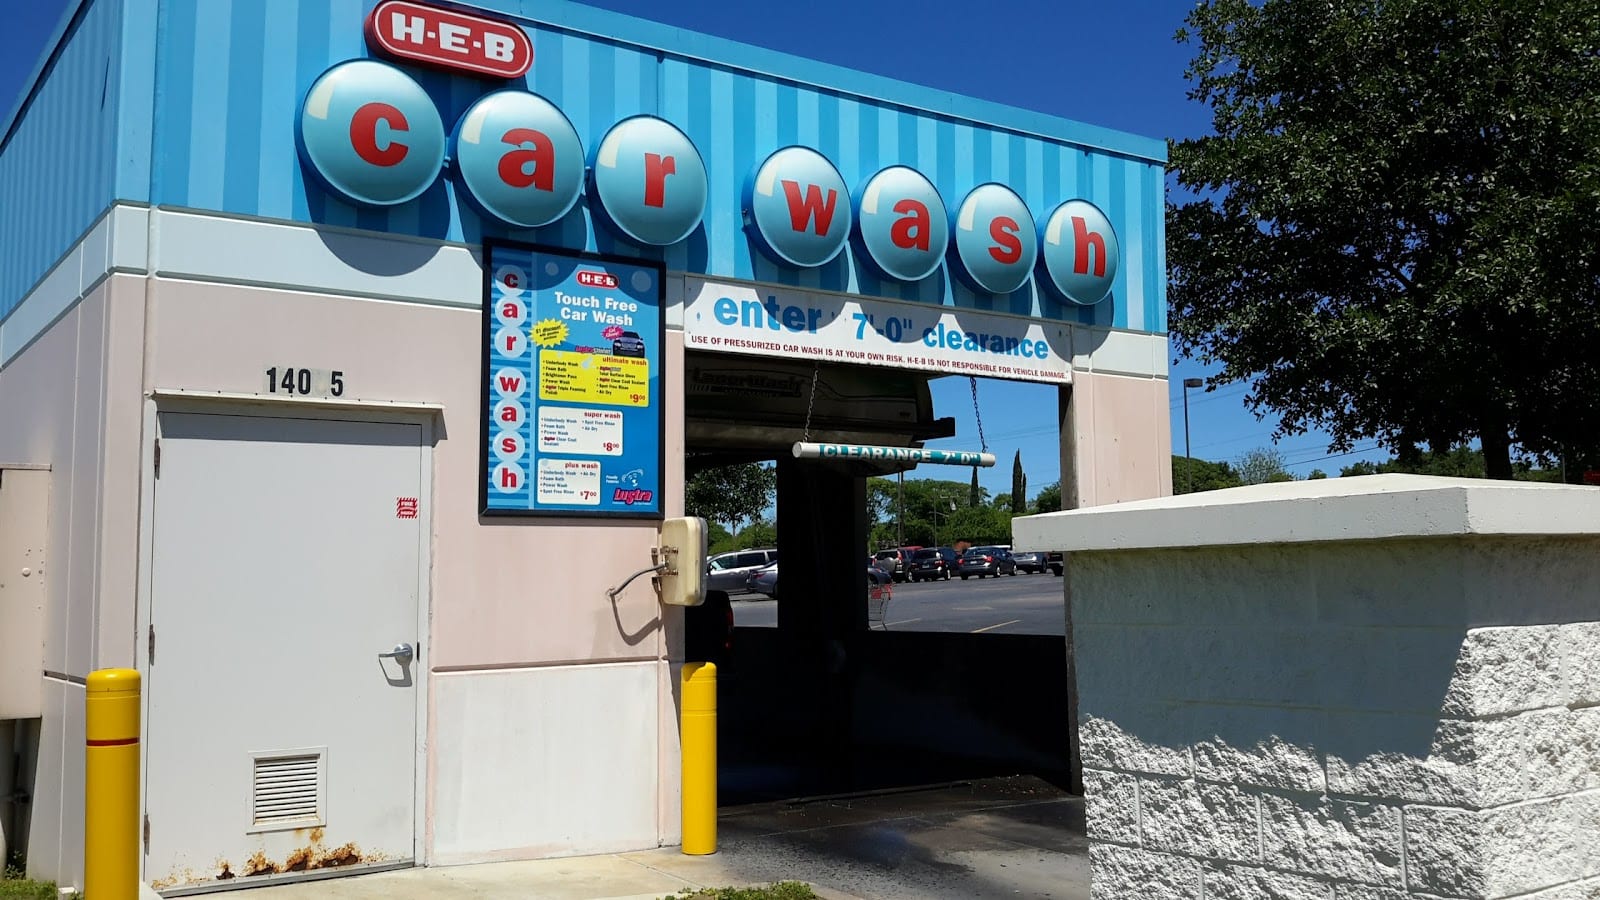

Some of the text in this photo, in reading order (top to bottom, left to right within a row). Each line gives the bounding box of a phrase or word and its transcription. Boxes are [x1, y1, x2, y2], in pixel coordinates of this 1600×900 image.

[391, 12, 516, 63] H-E-B
[350, 102, 1106, 278] car wash
[554, 291, 638, 313] Touch Free
[560, 307, 633, 326] Car Wash
[713, 295, 822, 334] enter
[922, 323, 1049, 359] clearance
[602, 356, 629, 364] ultimate
[691, 335, 708, 344] USE
[710, 337, 722, 345] OF
[724, 338, 781, 351] PRESSURIZED
[783, 344, 800, 353] CAR
[801, 345, 824, 356] WASH
[825, 348, 833, 357] IS
[835, 349, 844, 358] AT
[845, 350, 866, 360] YOUR
[867, 352, 885, 362] OWN
[886, 354, 905, 364] RISK.
[907, 356, 927, 366] H-E-B
[928, 358, 935, 366] IS
[937, 359, 950, 368] NOT
[952, 360, 997, 373] RESPONSIBLE
[998, 365, 1012, 374] FOR
[1013, 366, 1039, 378] VEHICLE
[266, 367, 344, 396] 140 5
[824, 445, 932, 462] CLEARANCE
